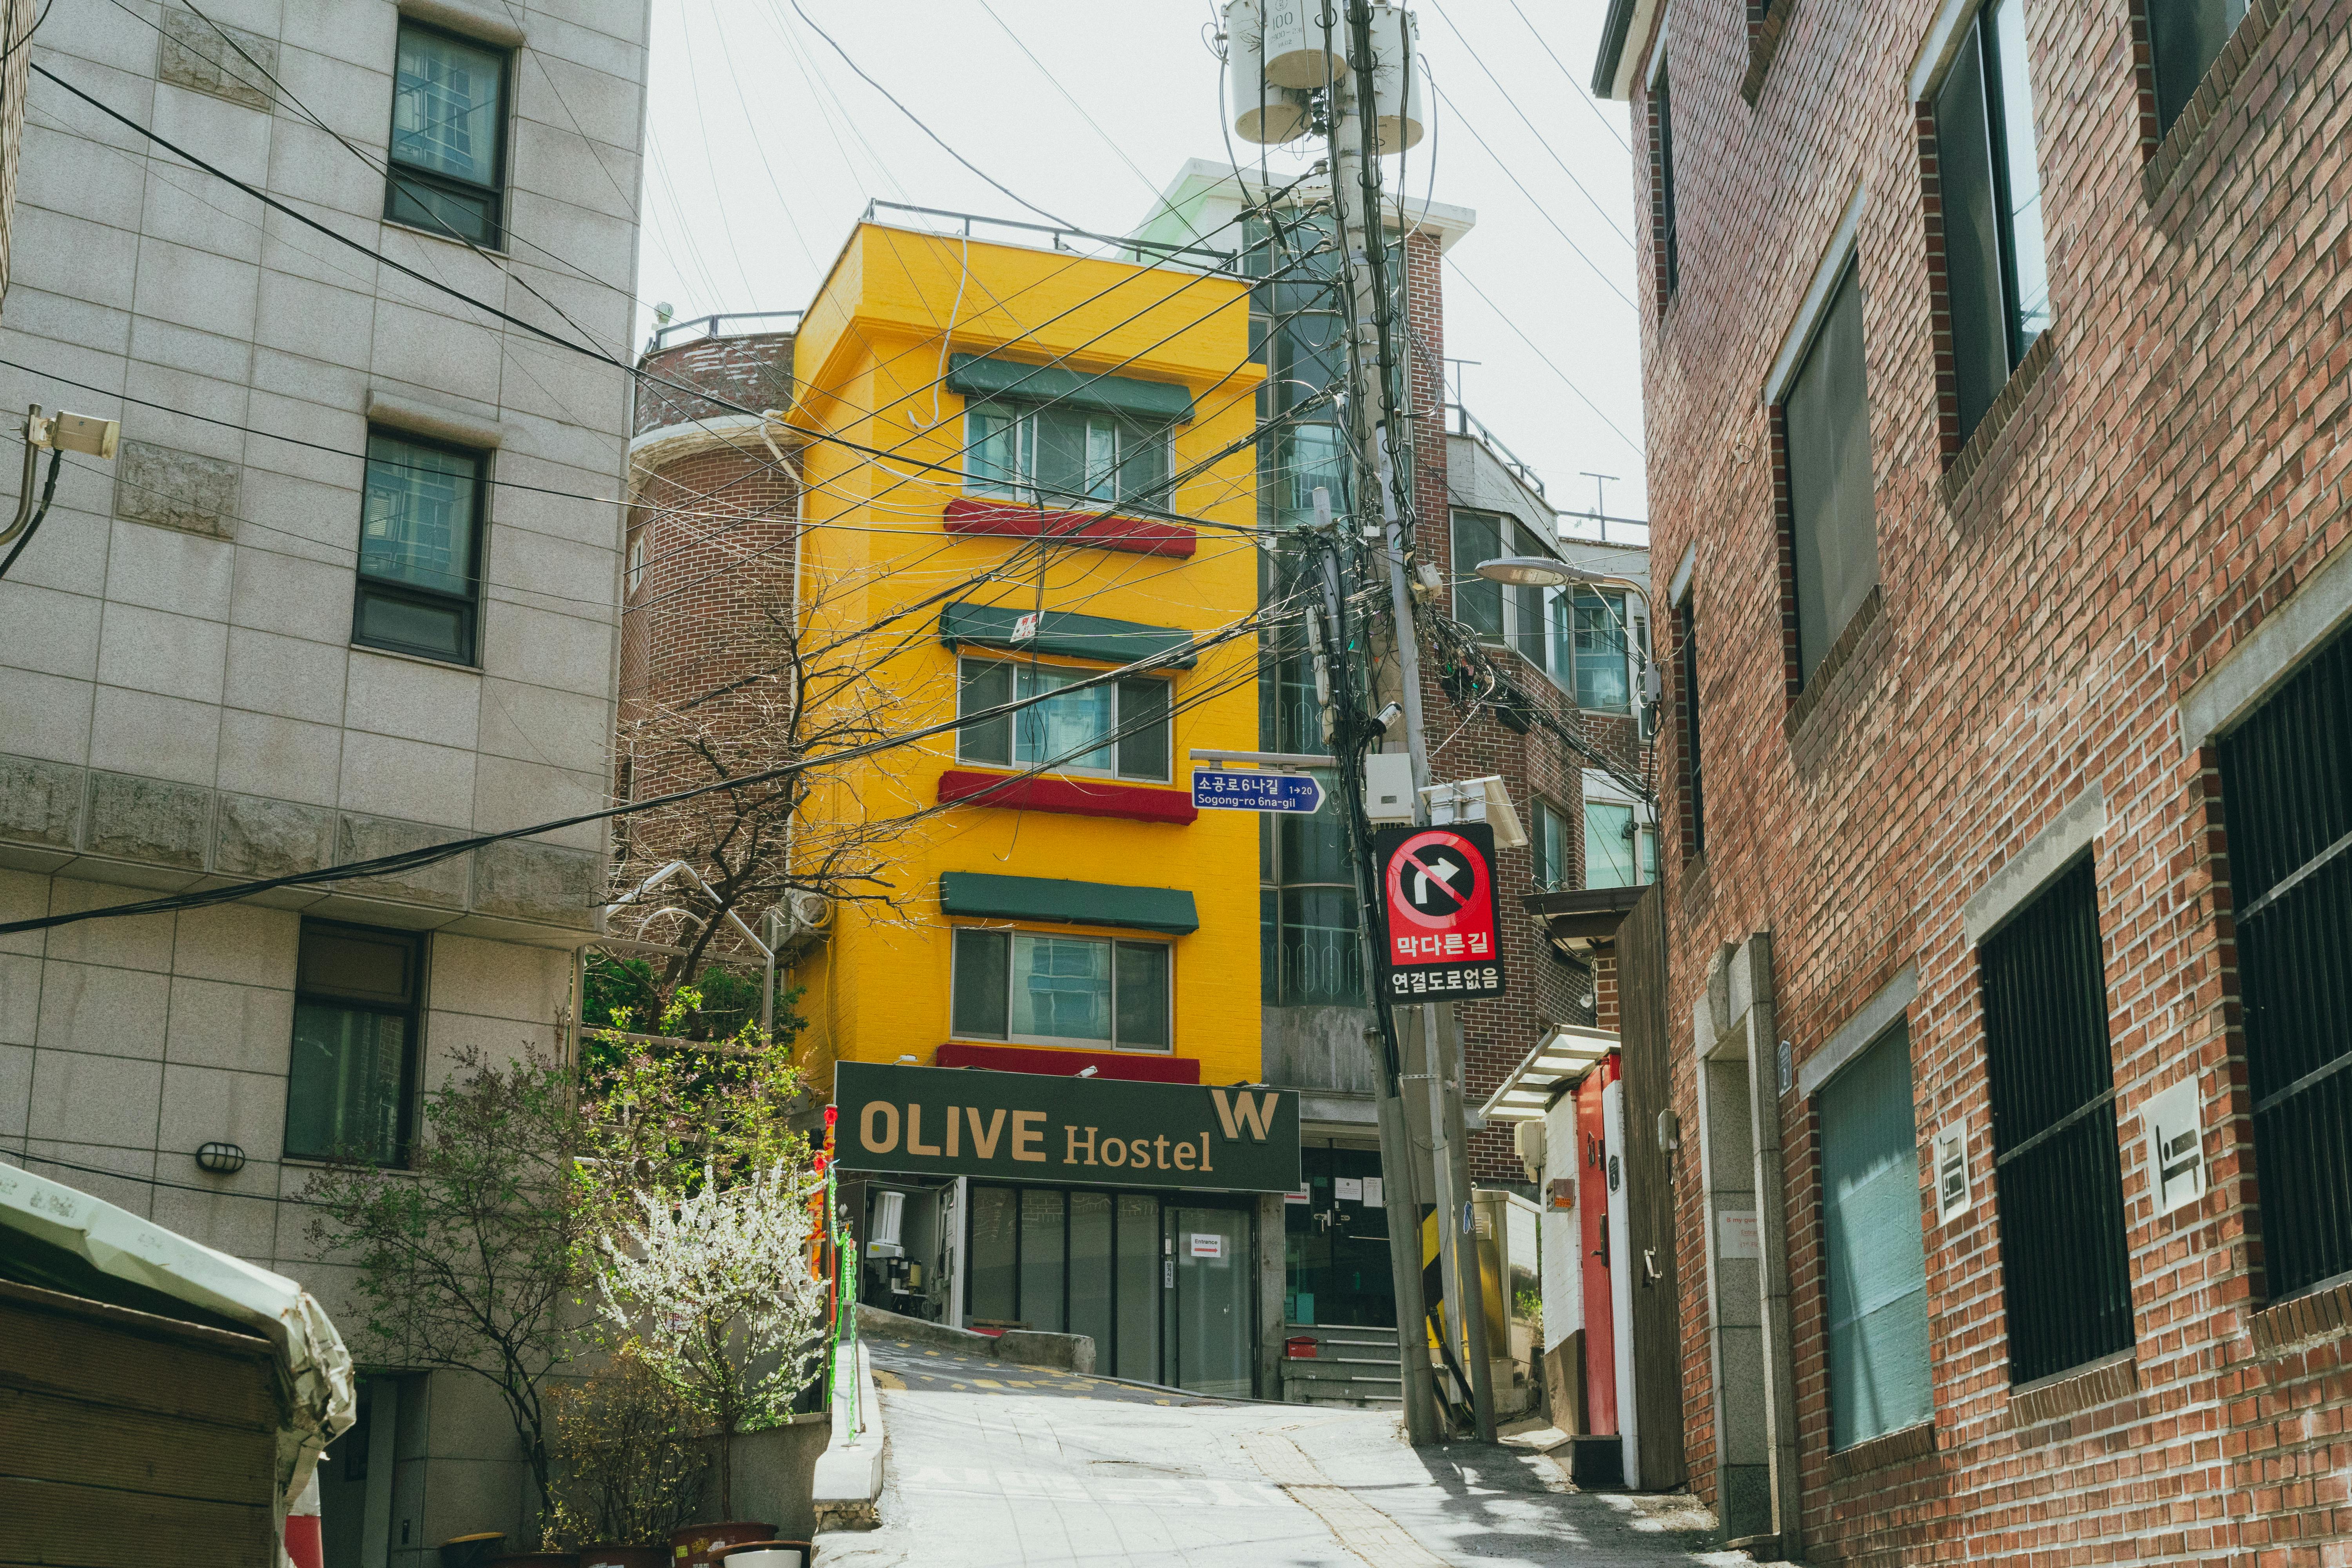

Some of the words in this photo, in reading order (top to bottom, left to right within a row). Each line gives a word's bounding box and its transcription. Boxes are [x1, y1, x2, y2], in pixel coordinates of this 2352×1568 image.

[1273, 12, 1292, 30] 100
[1198, 777, 1278, 795] 소공로6나길
[1198, 794, 1255, 807] Sogong-ro
[1258, 797, 1295, 809] 6na-gil
[1397, 932, 1488, 957] 막다른길
[1392, 968, 1499, 994] 연결도로없음
[860, 1100, 1047, 1162] OLIVE
[1063, 1125, 1213, 1172] Hostel
